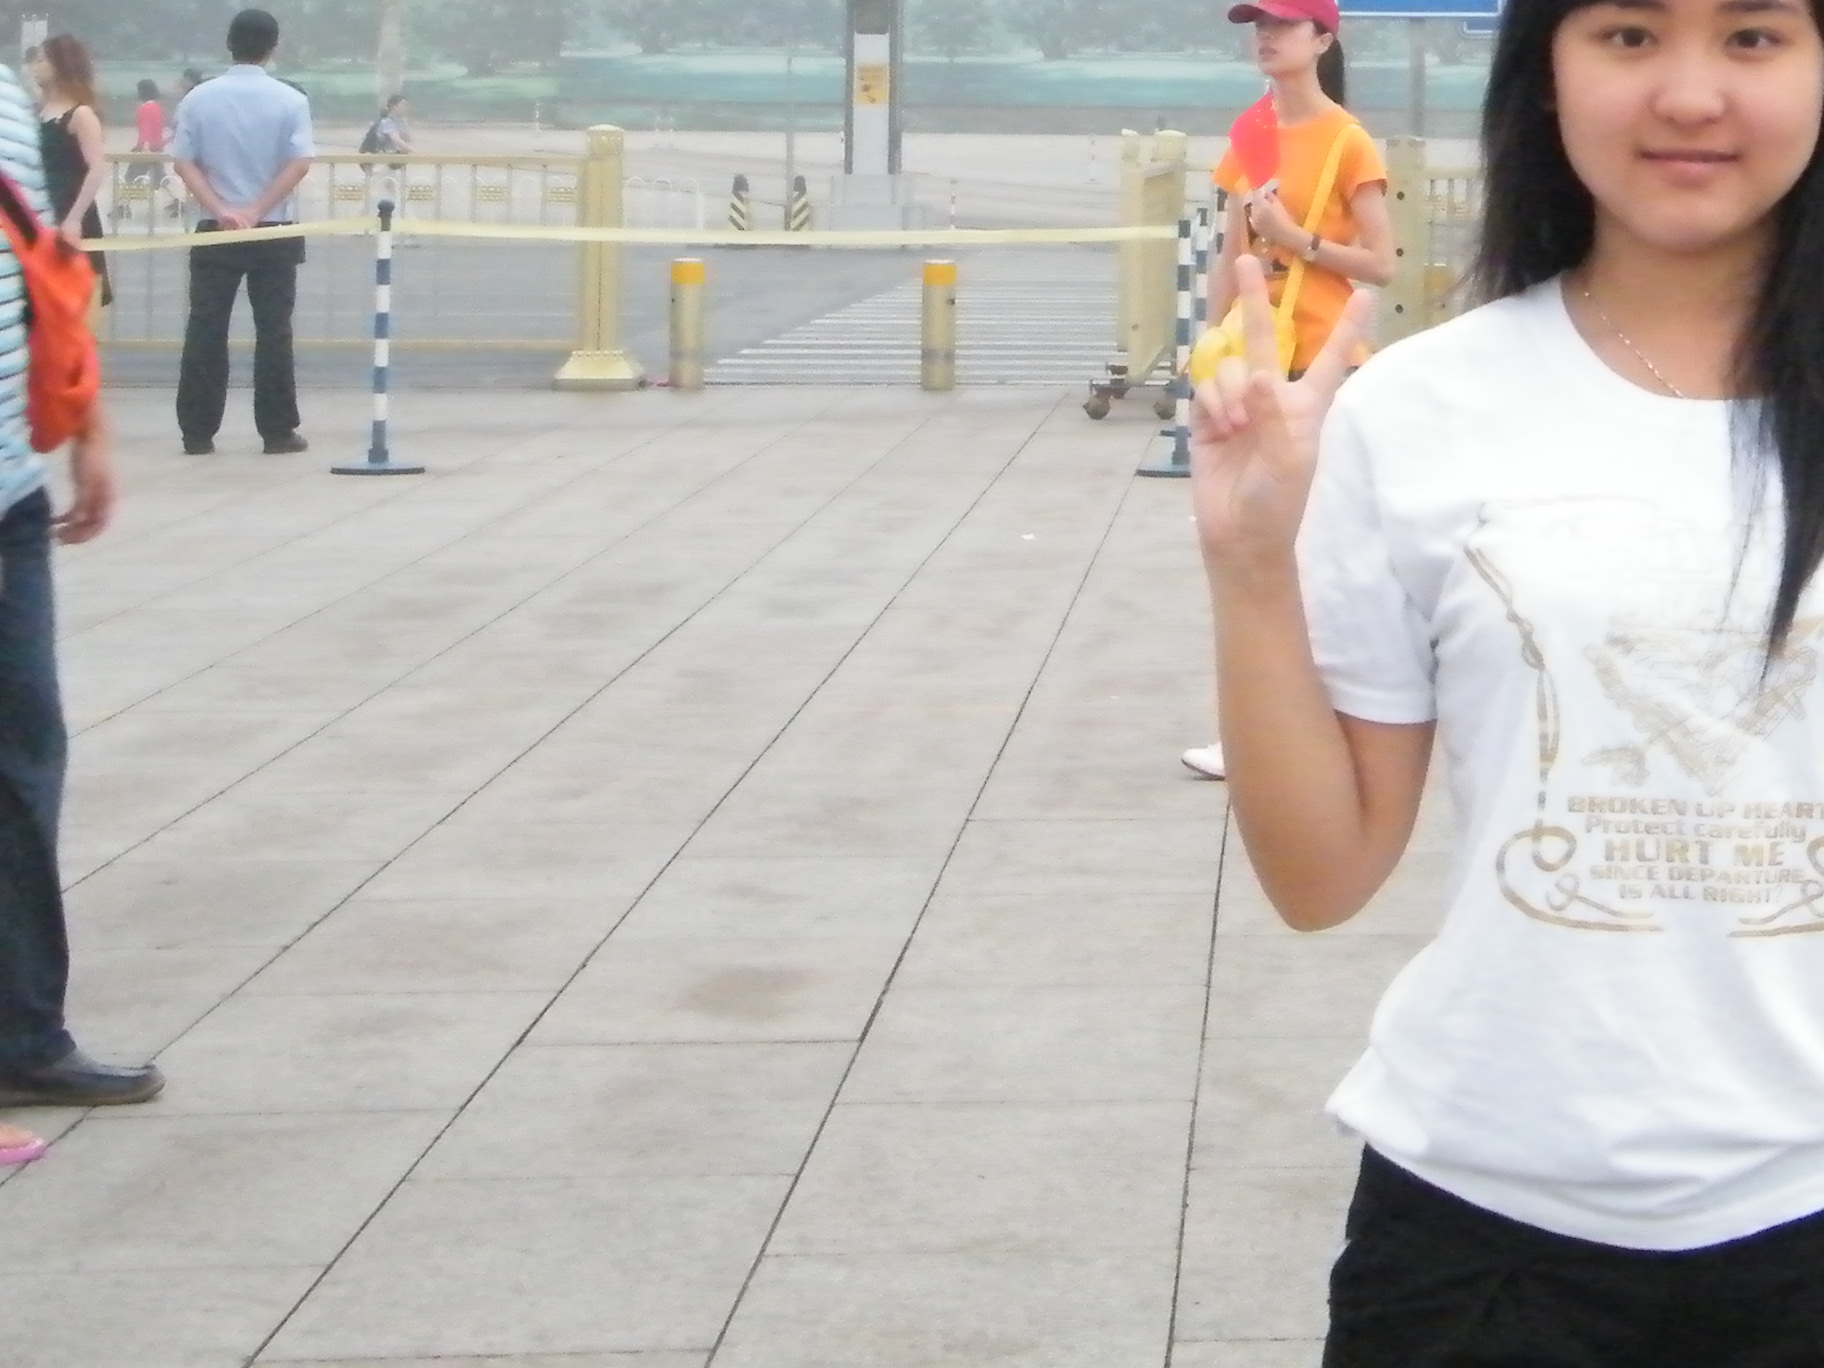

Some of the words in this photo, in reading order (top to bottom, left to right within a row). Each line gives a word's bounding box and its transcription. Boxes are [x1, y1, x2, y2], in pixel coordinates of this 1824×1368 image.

[1567, 795, 1687, 816] BROKEN
[1695, 801, 1736, 818] UP
[1585, 814, 1687, 835] Protect
[1604, 838, 1716, 866] HURT
[1732, 841, 1785, 868] ME
[1589, 864, 1661, 881] SINCE
[1667, 866, 1807, 885] DEPARTURE
[1618, 884, 1643, 899] IS
[1649, 884, 1697, 901] ALL
